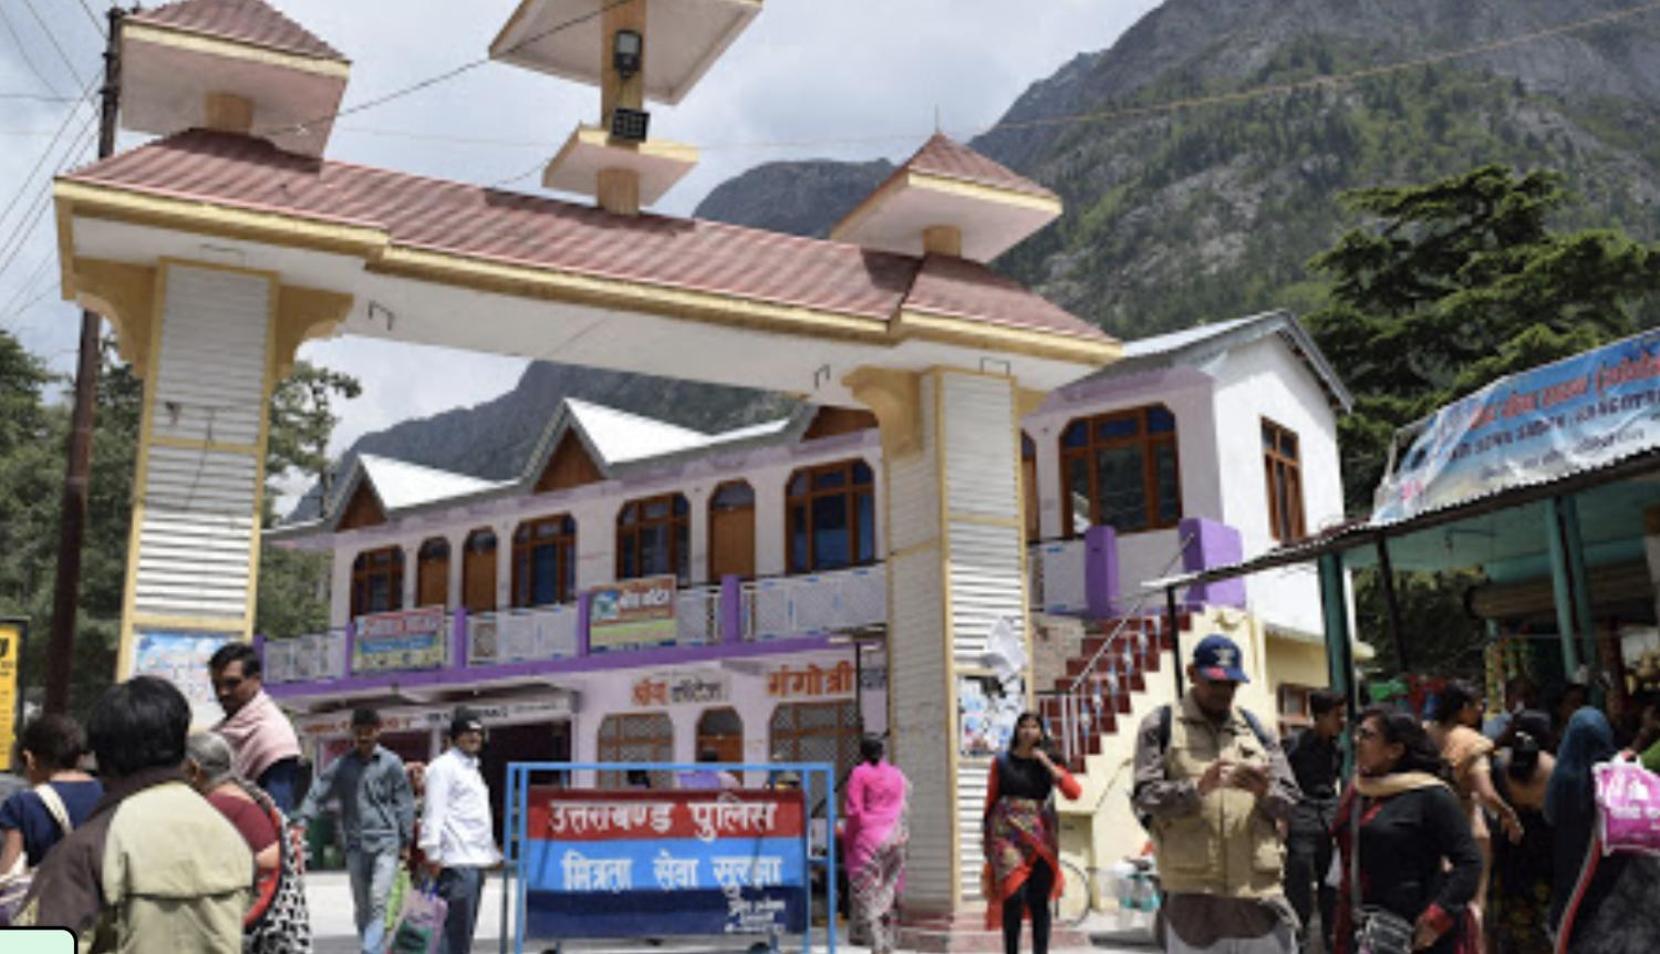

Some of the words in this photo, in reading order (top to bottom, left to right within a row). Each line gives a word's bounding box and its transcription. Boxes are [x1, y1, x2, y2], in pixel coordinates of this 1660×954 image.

[767, 660, 855, 696] गंगोत्री
[687, 792, 777, 840] पुलिस
[561, 850, 632, 891] मित्रता
[653, 849, 699, 891] सेवा
[712, 855, 783, 898] सुरक्षा
